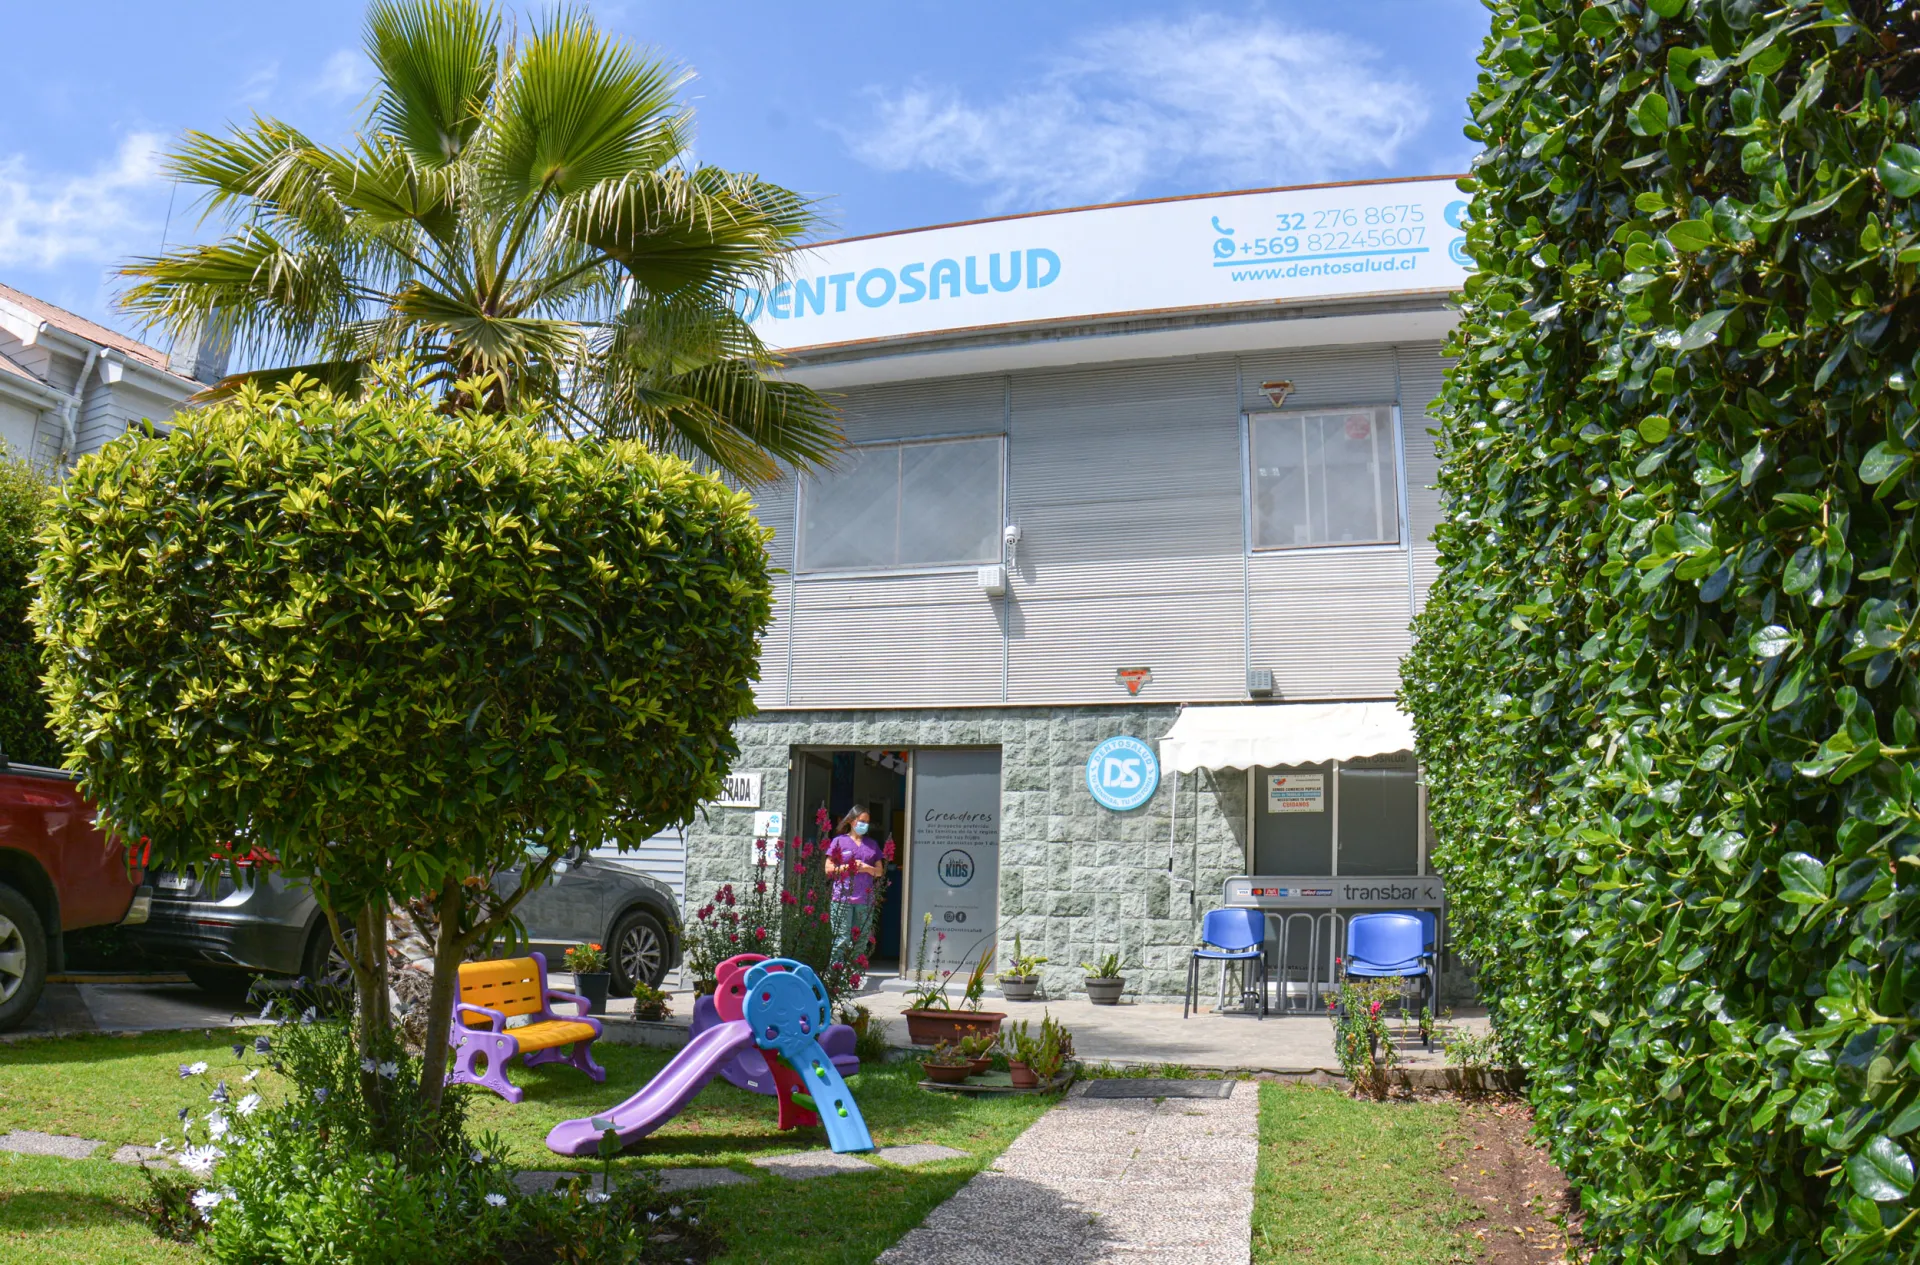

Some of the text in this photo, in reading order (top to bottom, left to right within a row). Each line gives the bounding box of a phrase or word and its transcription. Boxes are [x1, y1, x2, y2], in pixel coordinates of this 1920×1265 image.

[1276, 204, 1425, 231] 32 276 8675
[1240, 226, 1426, 256] +569 82245607
[1231, 256, 1417, 282] www.dentosalud.cl
[735, 247, 1061, 324] DENTOSALUD
[1094, 740, 1152, 765] DENTOSALUD
[1103, 758, 1141, 788] DS
[925, 808, 992, 822] Creadores
[946, 864, 968, 877] KIDS
